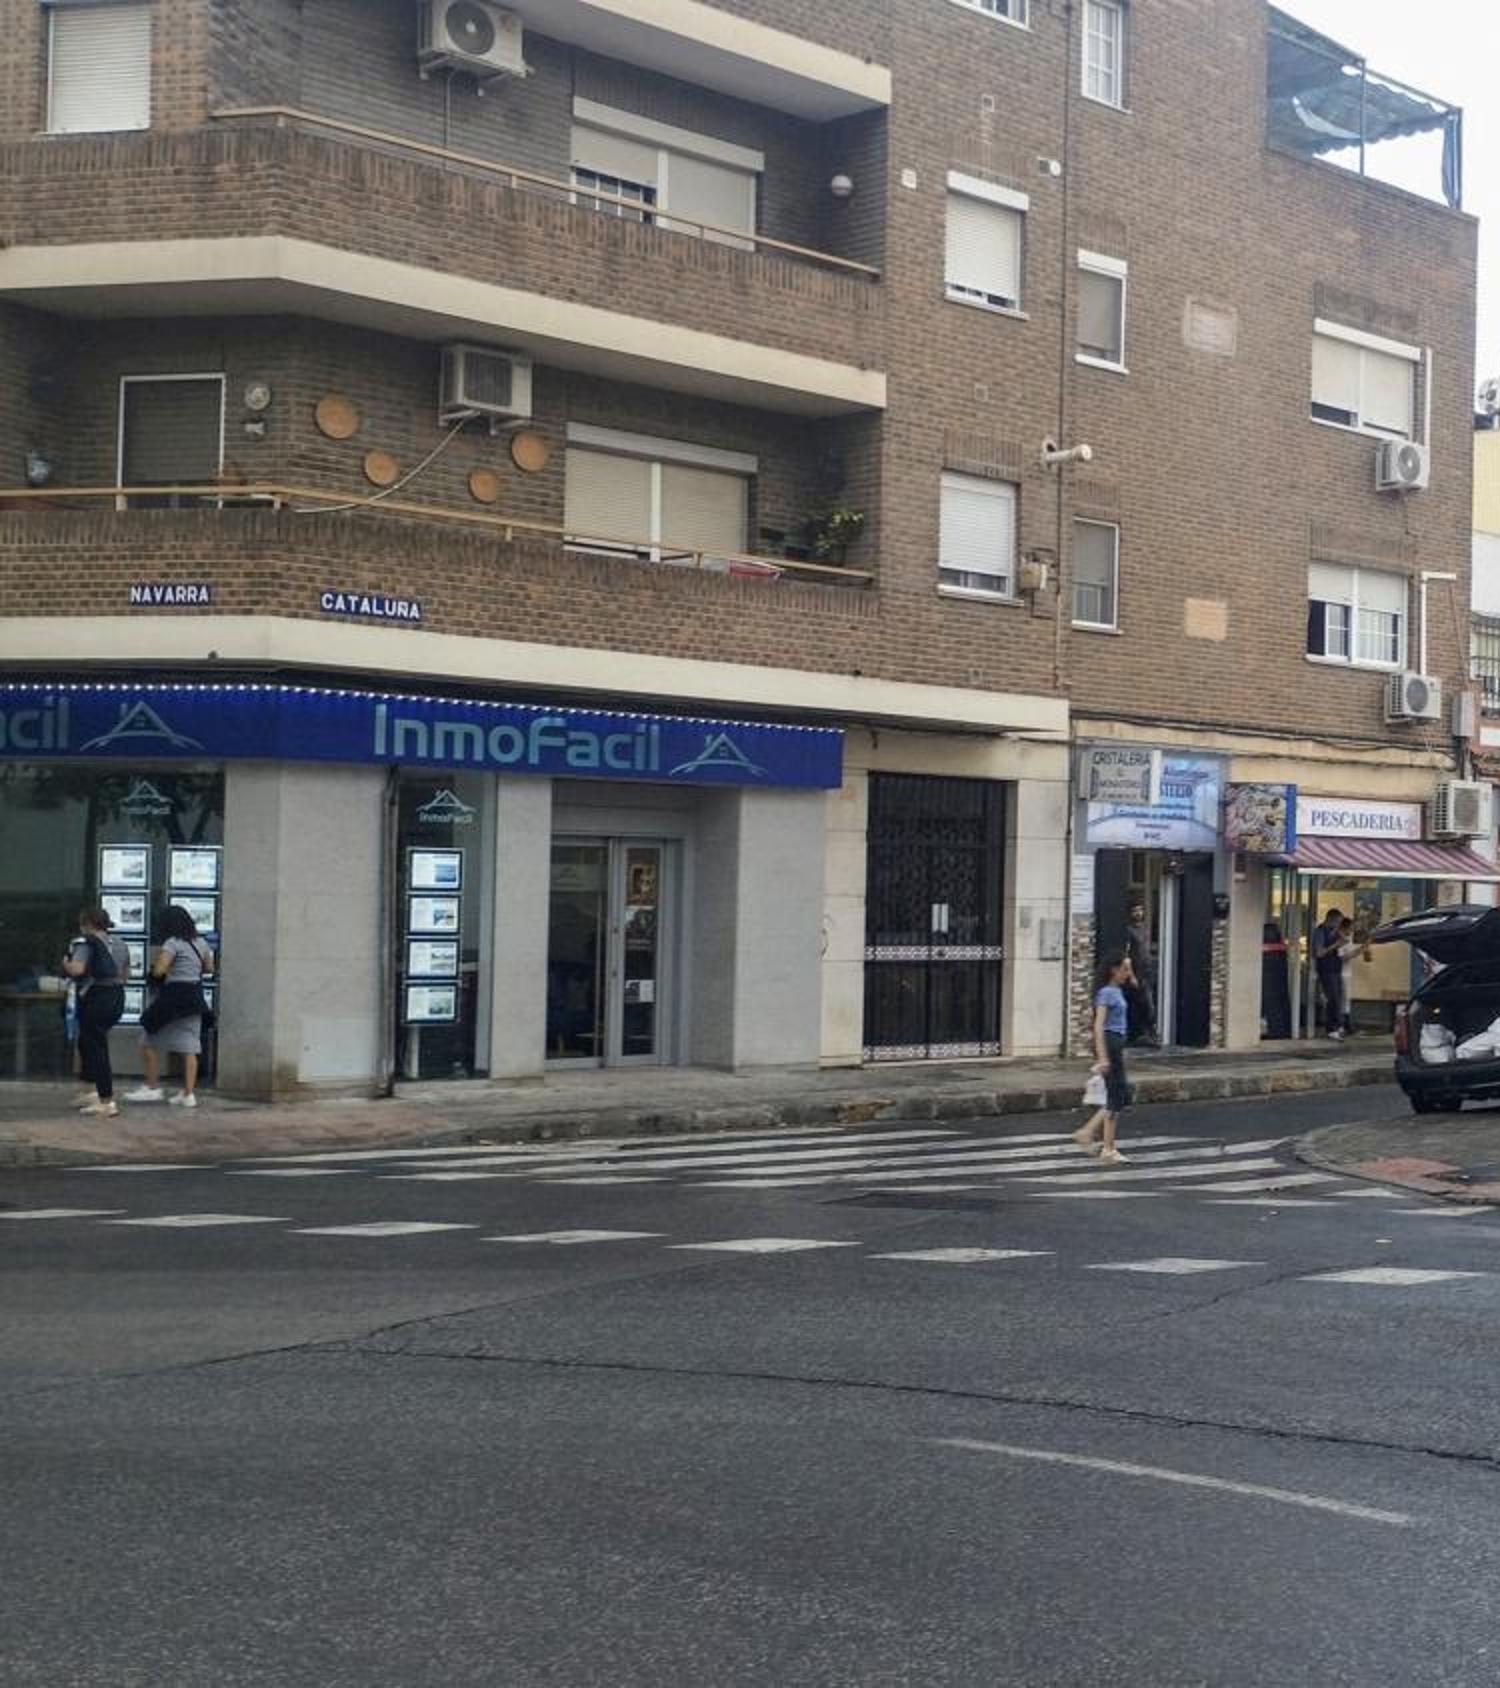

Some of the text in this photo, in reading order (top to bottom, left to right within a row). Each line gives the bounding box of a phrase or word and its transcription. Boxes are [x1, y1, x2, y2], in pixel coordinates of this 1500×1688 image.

[130, 586, 209, 603] NAVARRA
[0, 696, 71, 750] cil
[1311, 810, 1403, 831] PESCADERIA
